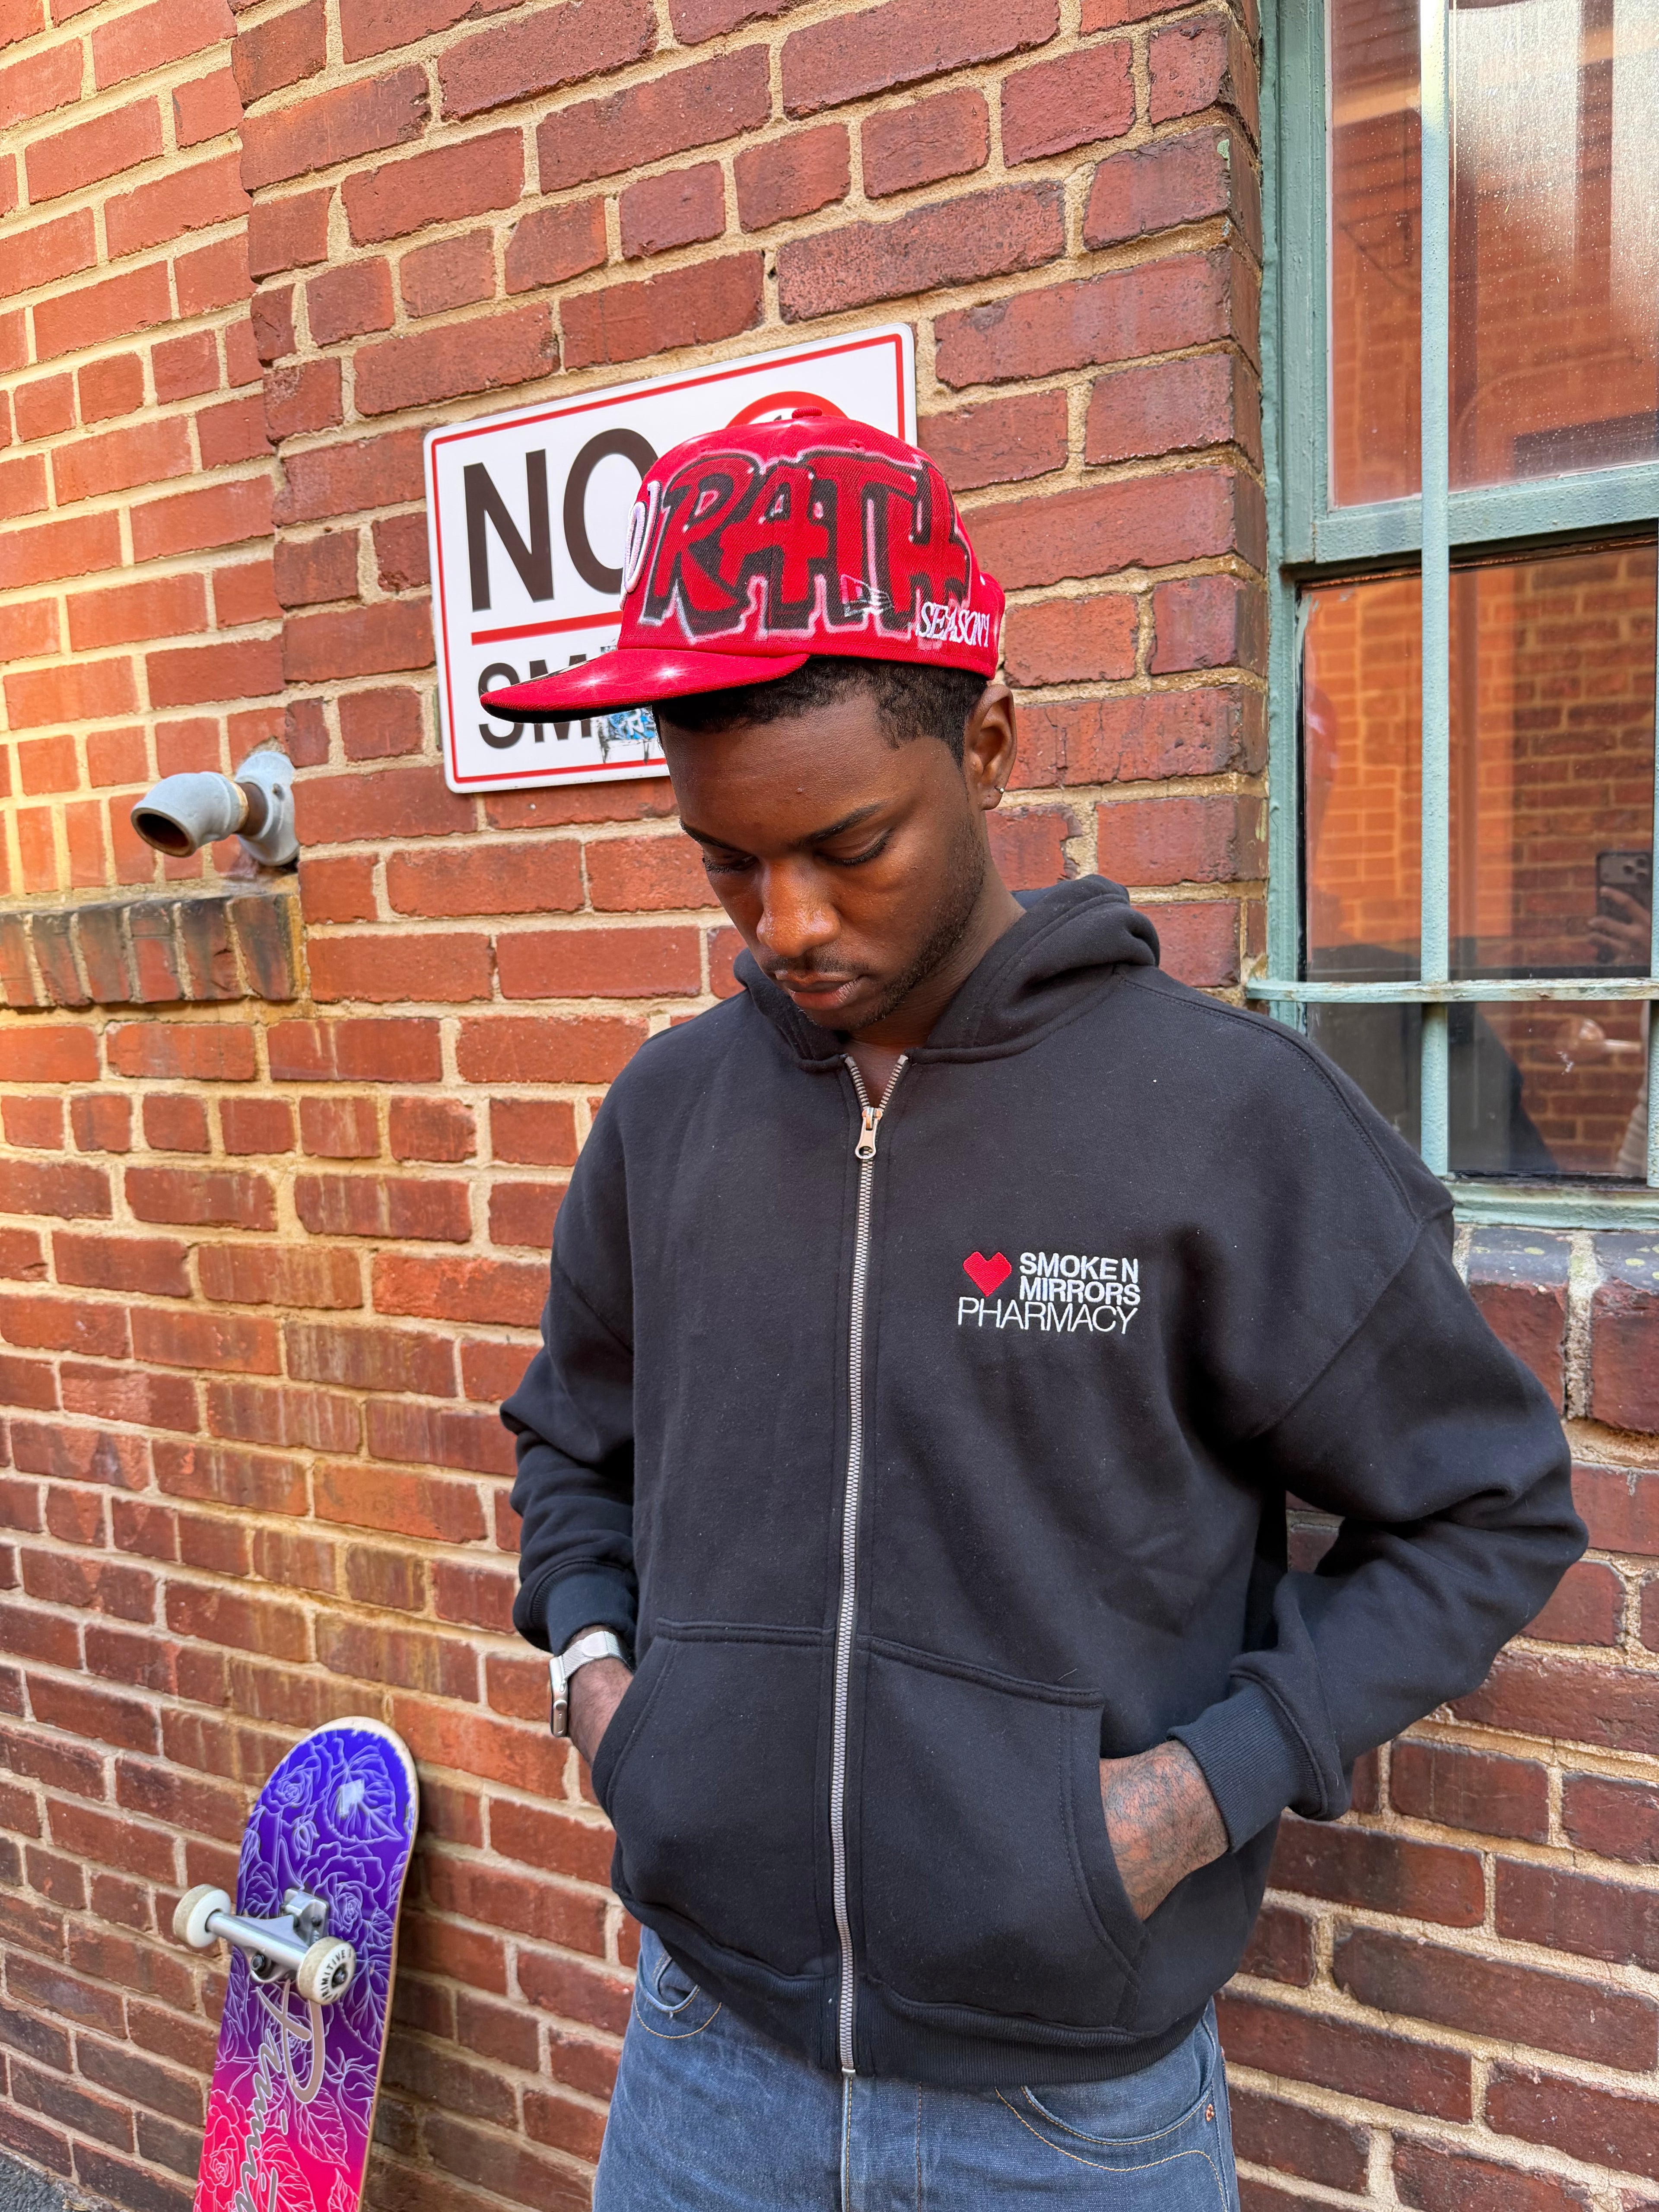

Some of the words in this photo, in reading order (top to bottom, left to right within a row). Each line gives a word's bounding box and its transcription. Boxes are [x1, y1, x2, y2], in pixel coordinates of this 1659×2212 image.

[463, 428, 658, 613] NO
[1020, 1276, 1140, 1305] MIRRORS
[958, 1297, 1138, 1334] PHARMACY
